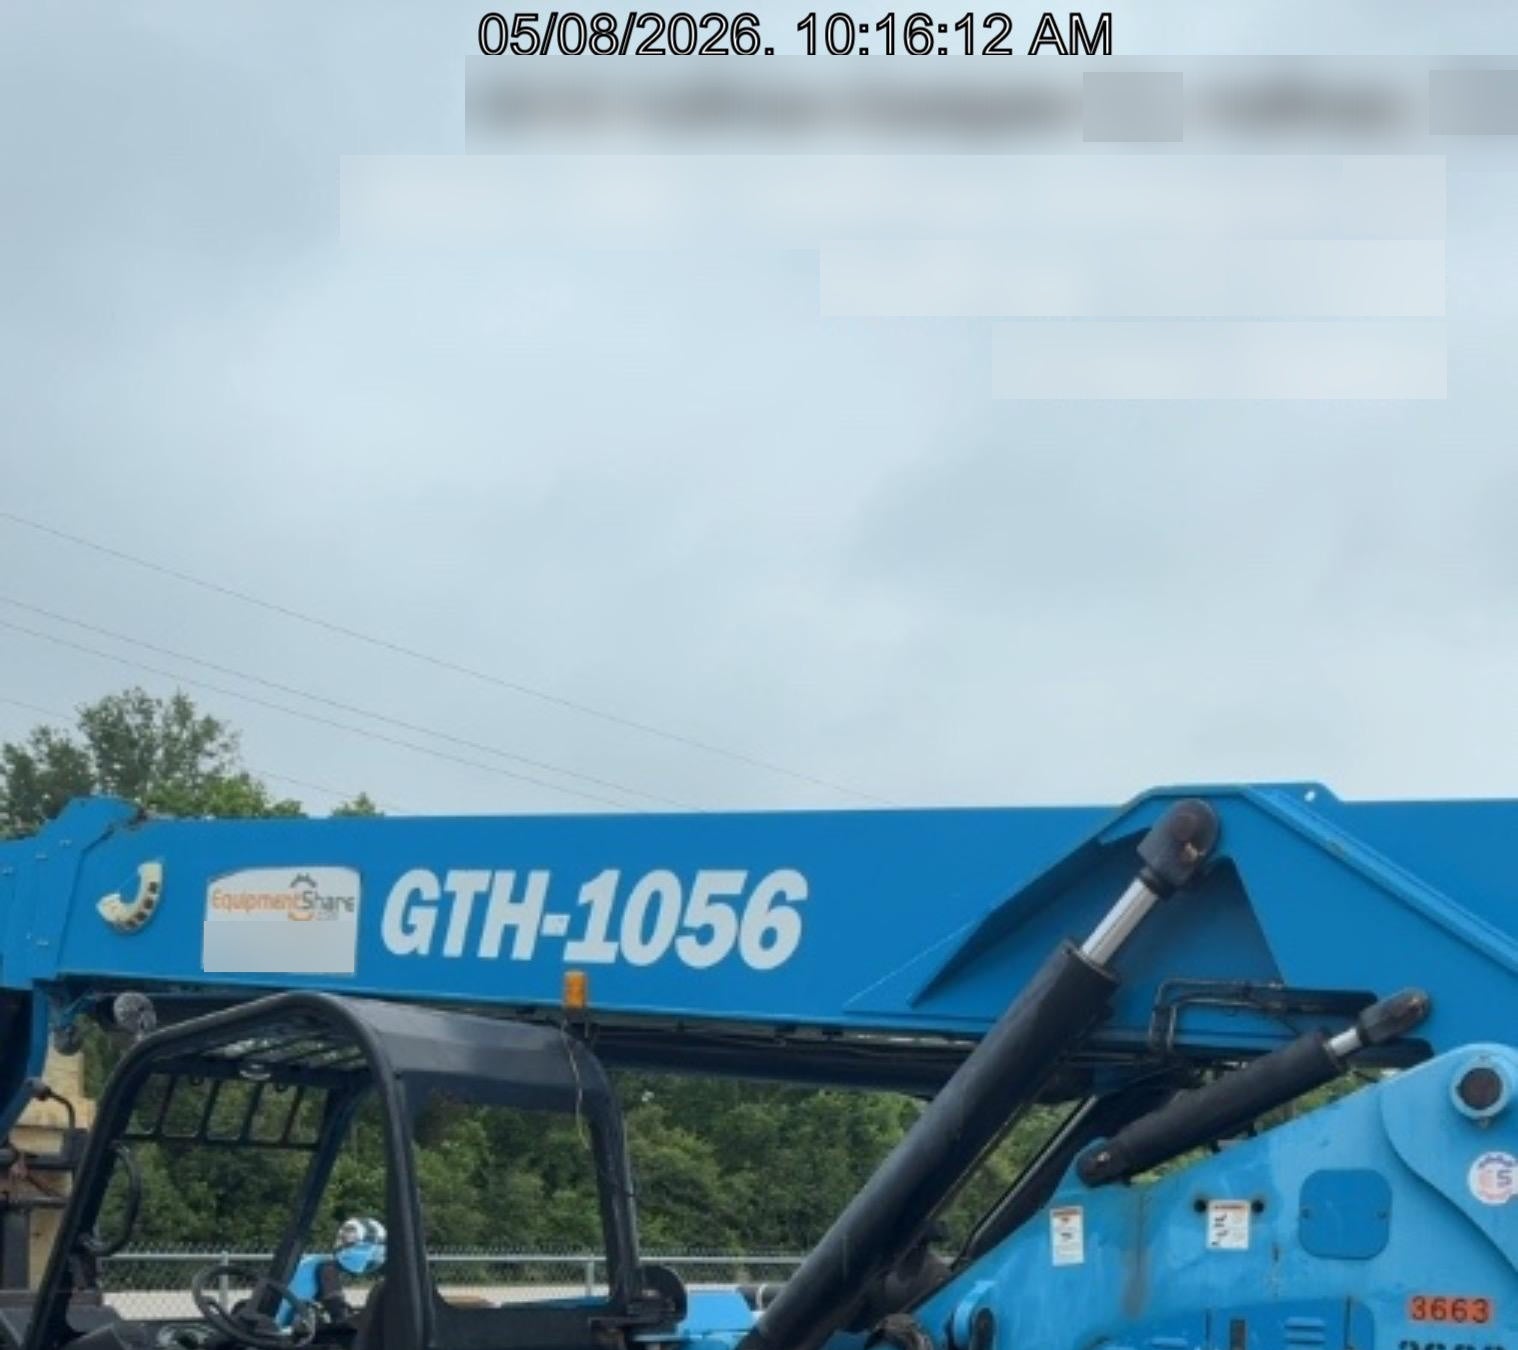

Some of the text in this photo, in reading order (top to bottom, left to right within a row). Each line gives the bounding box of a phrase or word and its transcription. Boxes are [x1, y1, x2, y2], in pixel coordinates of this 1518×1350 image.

[212, 888, 356, 914] EquipmentShare
[381, 868, 808, 970] GTH-1056
[1411, 1296, 1489, 1323] 3663
